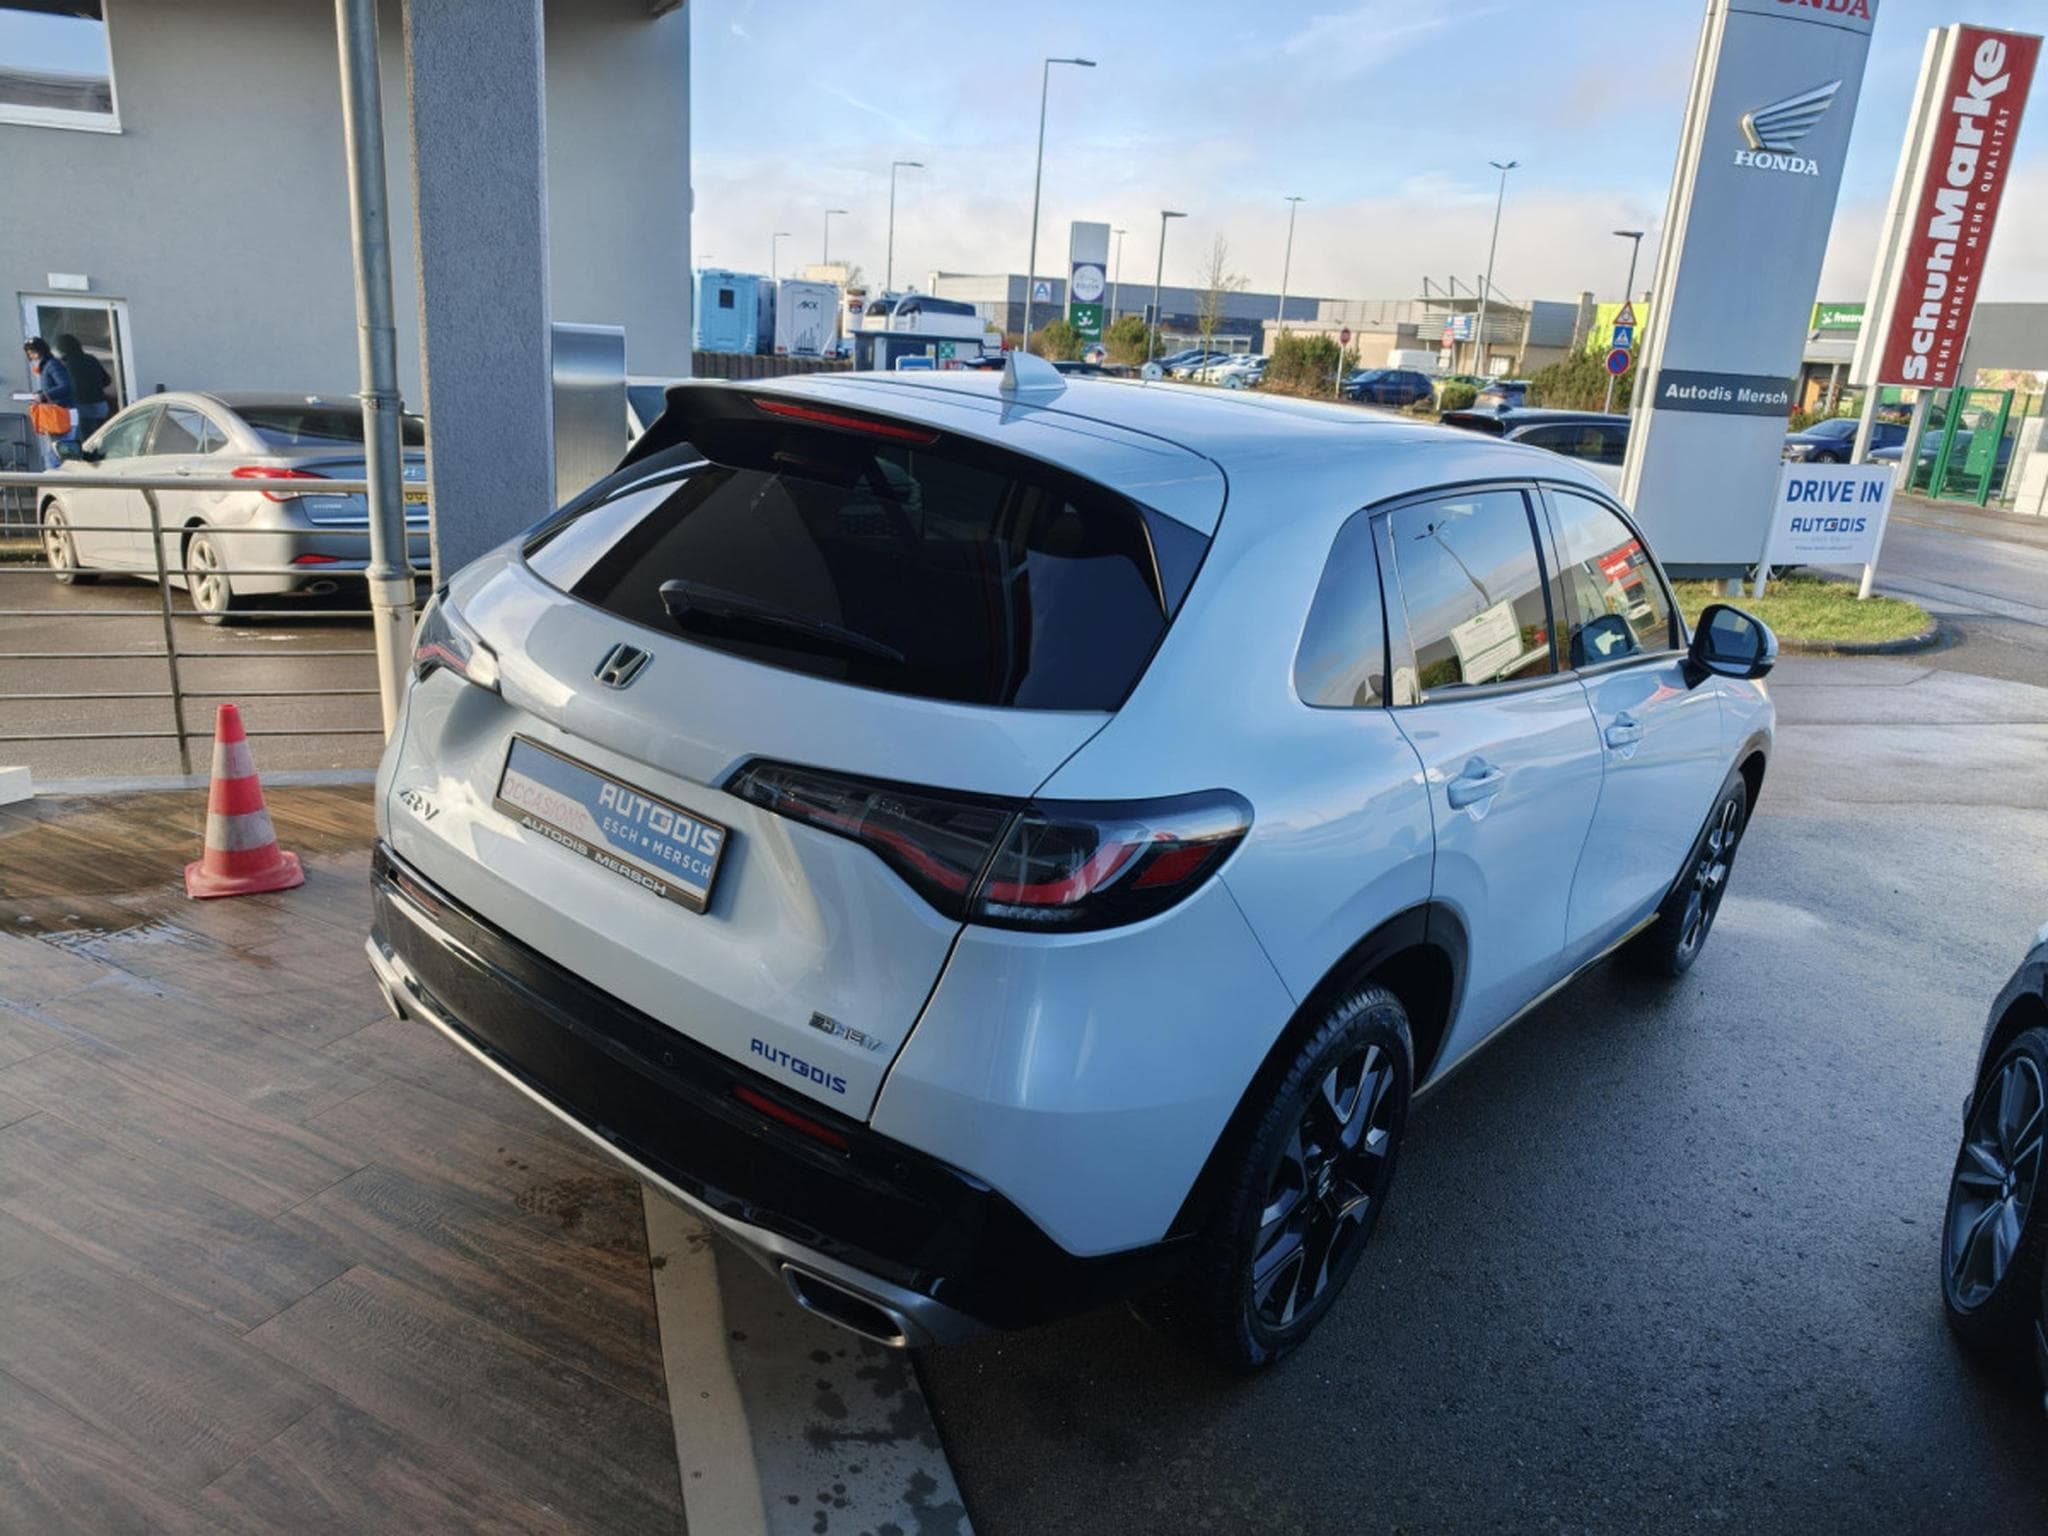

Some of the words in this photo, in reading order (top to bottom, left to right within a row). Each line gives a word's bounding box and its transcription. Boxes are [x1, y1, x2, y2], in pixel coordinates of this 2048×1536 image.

[1733, 150, 1820, 176] HONDA
[1902, 38, 2011, 380] SchuhMarke
[1934, 338, 1953, 382] MEHR
[1946, 275, 1969, 330] MARKE
[1966, 202, 1987, 248] MEHR
[1665, 383, 1733, 401] Autodis
[1737, 388, 1788, 404] Mersch
[1786, 480, 1856, 502] DRIVE
[1860, 481, 1884, 502] IN
[1790, 518, 1867, 532] AUTODIS
[598, 782, 720, 856] AUTODIS
[603, 816, 639, 843] ESCH
[652, 840, 712, 878] MERSCH
[521, 816, 588, 855] AUTODIS
[593, 852, 667, 896] MERSCH
[751, 1038, 846, 1094] AUTODIS
